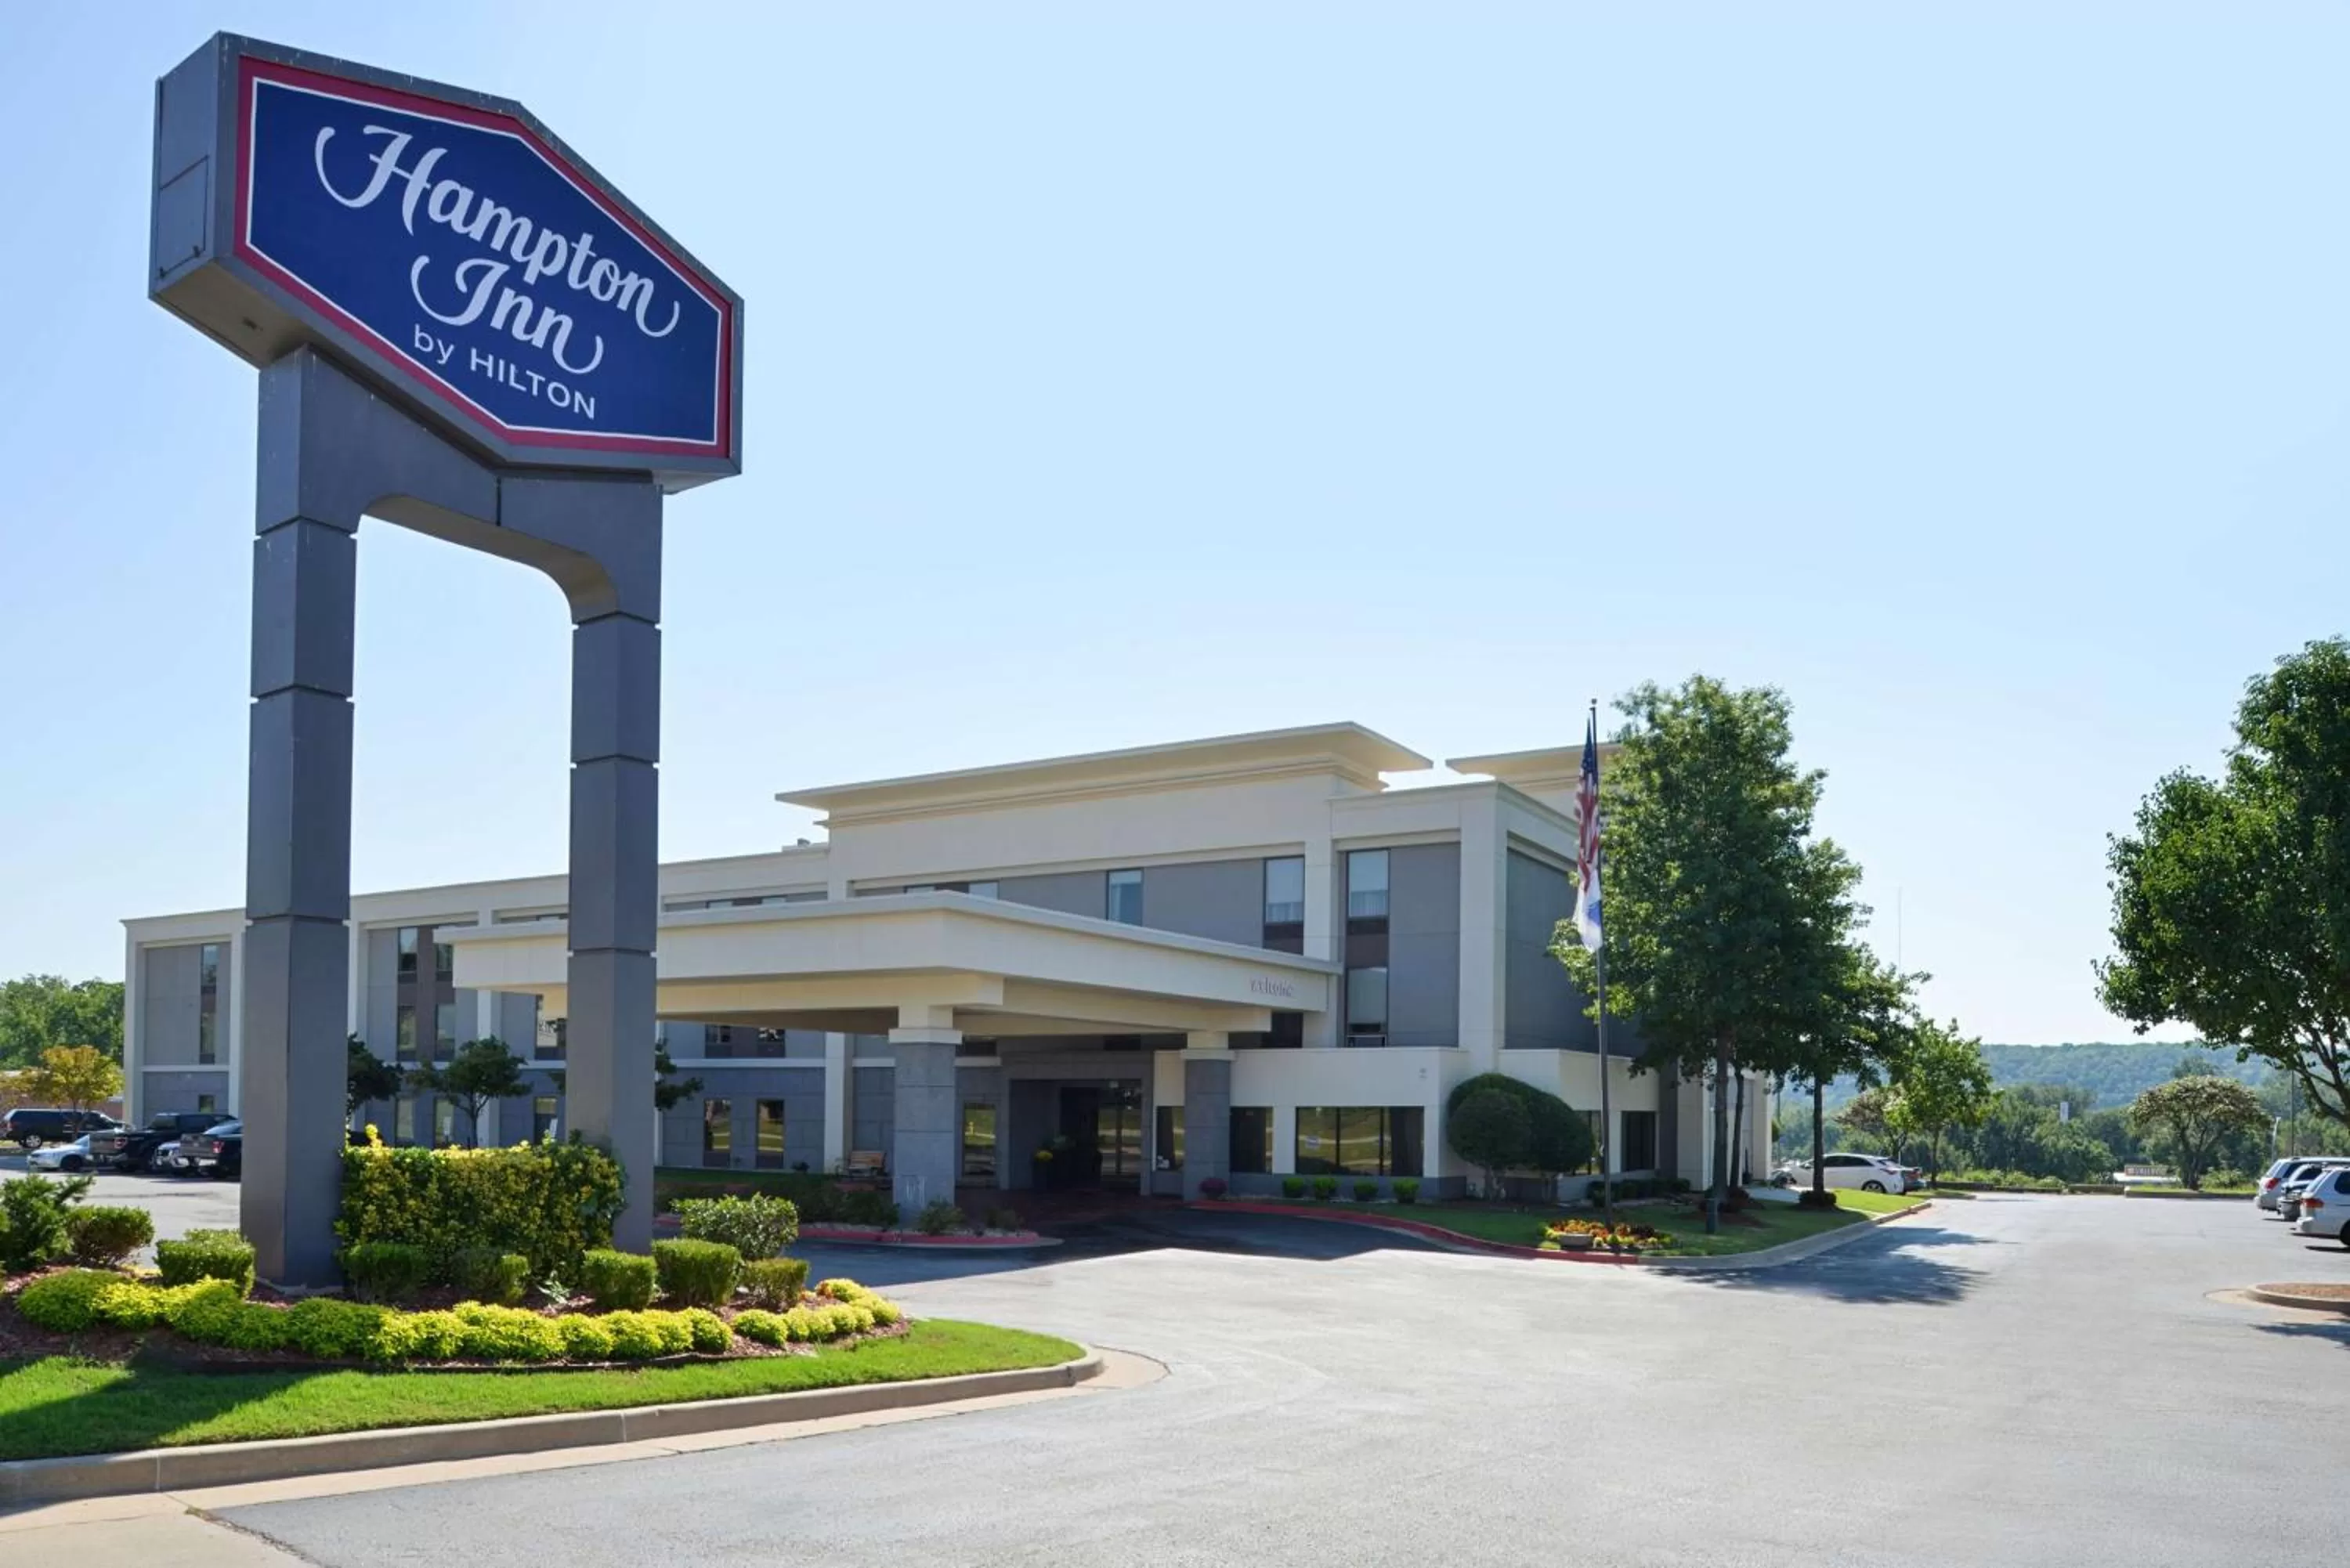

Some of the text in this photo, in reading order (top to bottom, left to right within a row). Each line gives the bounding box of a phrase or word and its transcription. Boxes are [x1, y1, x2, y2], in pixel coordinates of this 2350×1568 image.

[315, 125, 680, 338] Hampton
[410, 255, 603, 374] Inn
[414, 323, 595, 420] by HILTON
